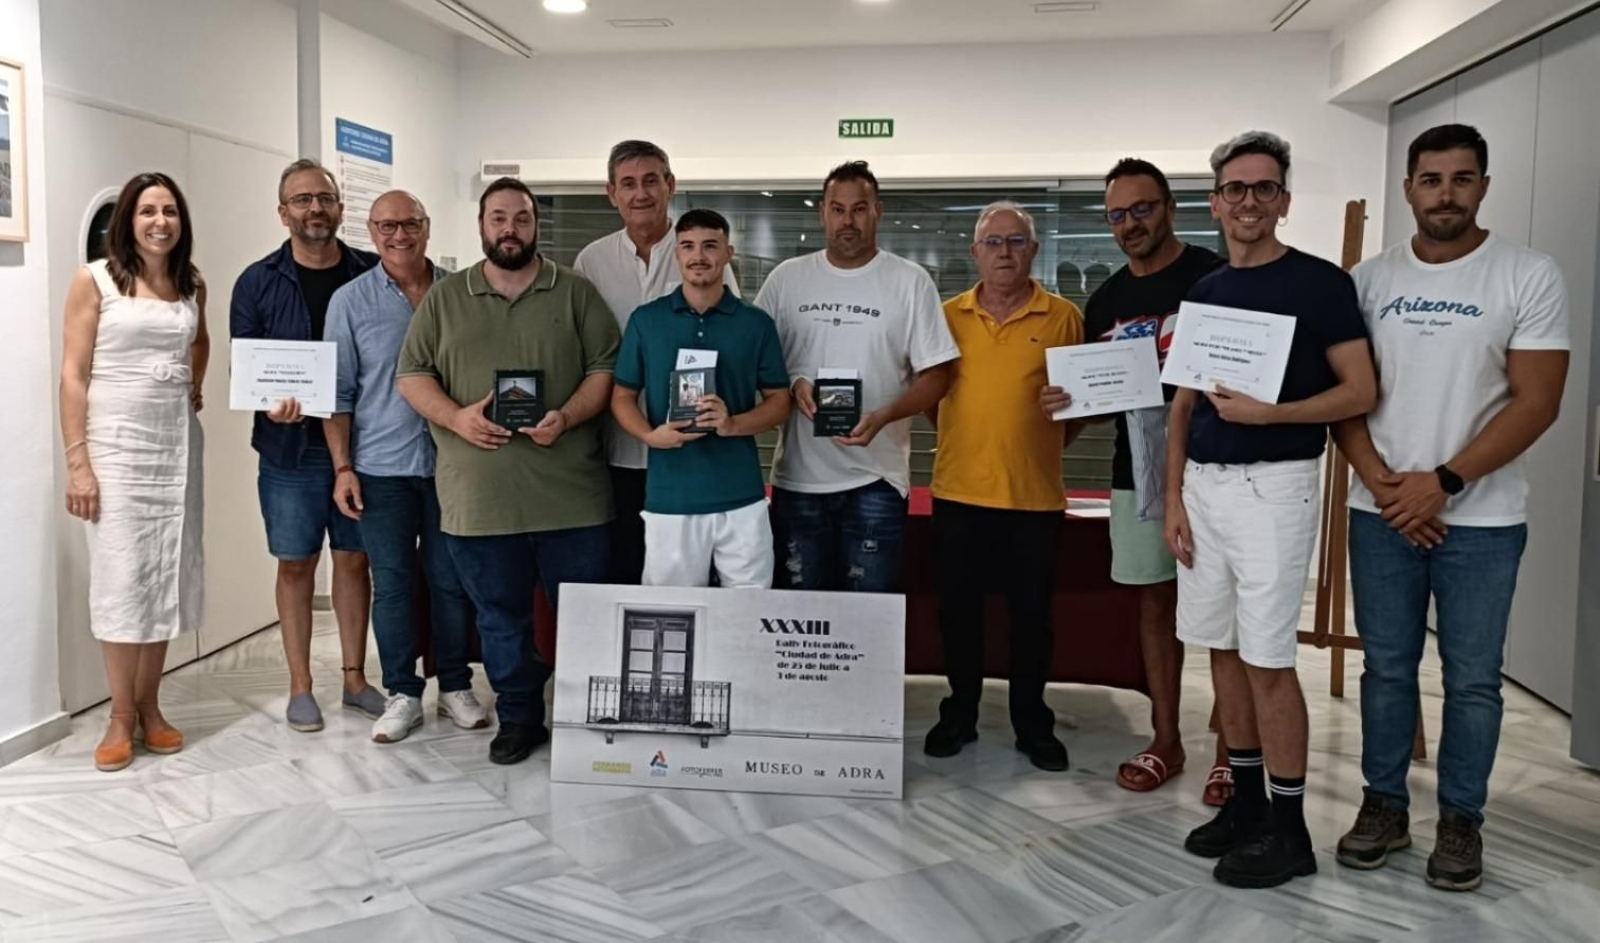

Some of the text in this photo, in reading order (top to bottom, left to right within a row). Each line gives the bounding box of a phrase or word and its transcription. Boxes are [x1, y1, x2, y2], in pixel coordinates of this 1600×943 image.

[842, 122, 890, 135] SALIDA
[798, 303, 880, 317] GANT 1949
[1380, 296, 1484, 320] Arizona
[760, 618, 830, 635] XXXIII
[785, 672, 797, 680] de
[745, 760, 885, 780] MUSEO DE ADRA
[1212, 771, 1234, 783] FIL
